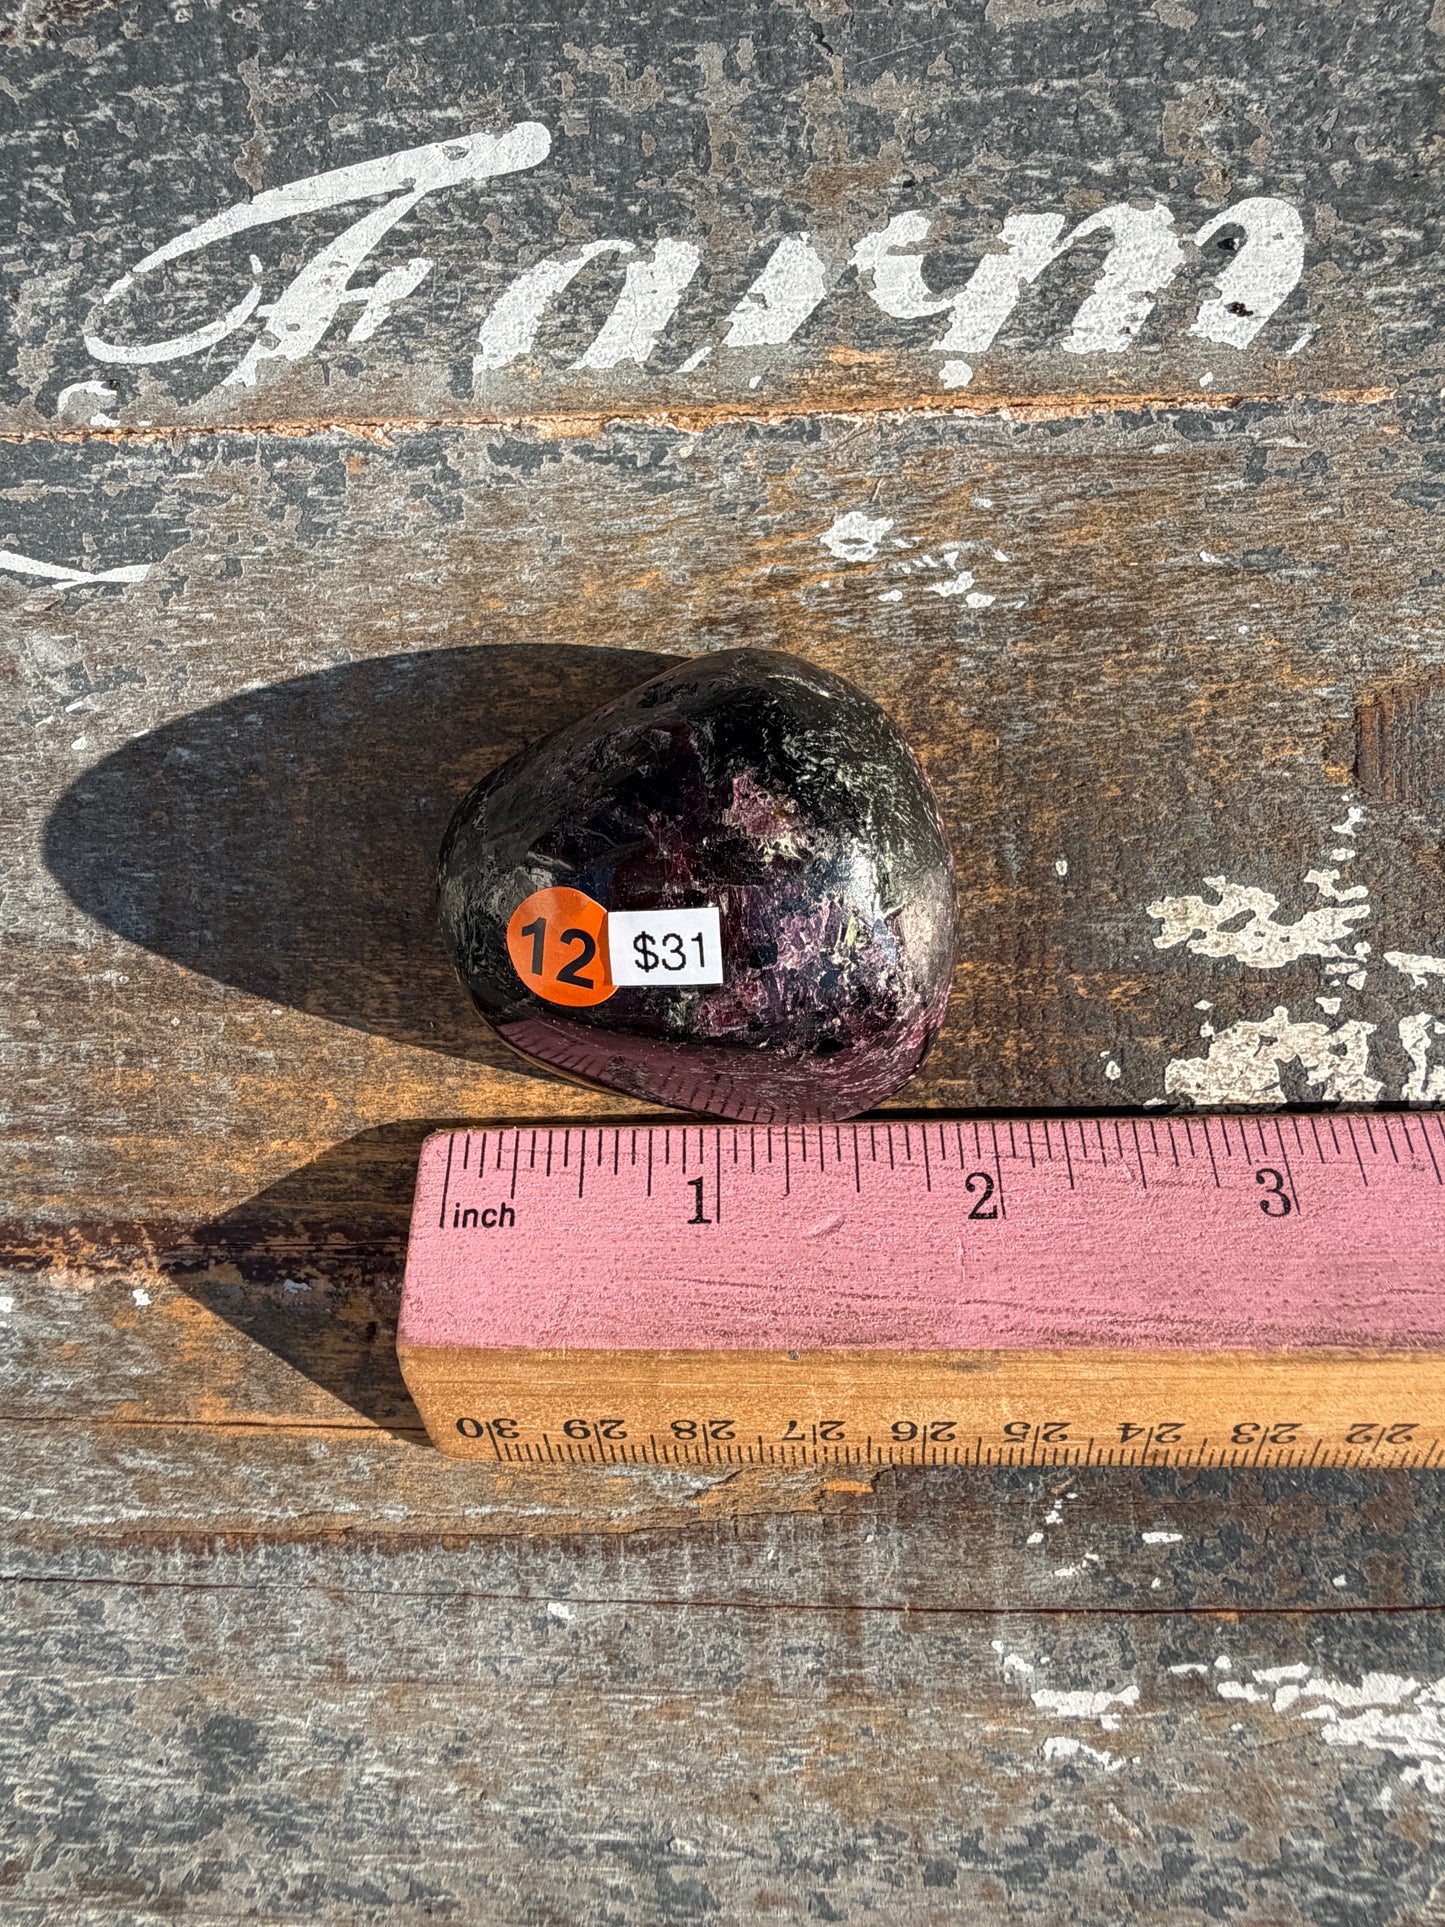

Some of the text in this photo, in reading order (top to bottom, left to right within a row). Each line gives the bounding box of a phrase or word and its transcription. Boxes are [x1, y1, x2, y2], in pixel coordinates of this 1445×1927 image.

[521, 917, 597, 990] 12
[633, 931, 706, 973] $31
[453, 1202, 516, 1229] inch
[687, 1168, 1292, 1224] 1 2 3
[455, 1416, 1421, 1445] 22 23 24 25 26 27 28 29 30
